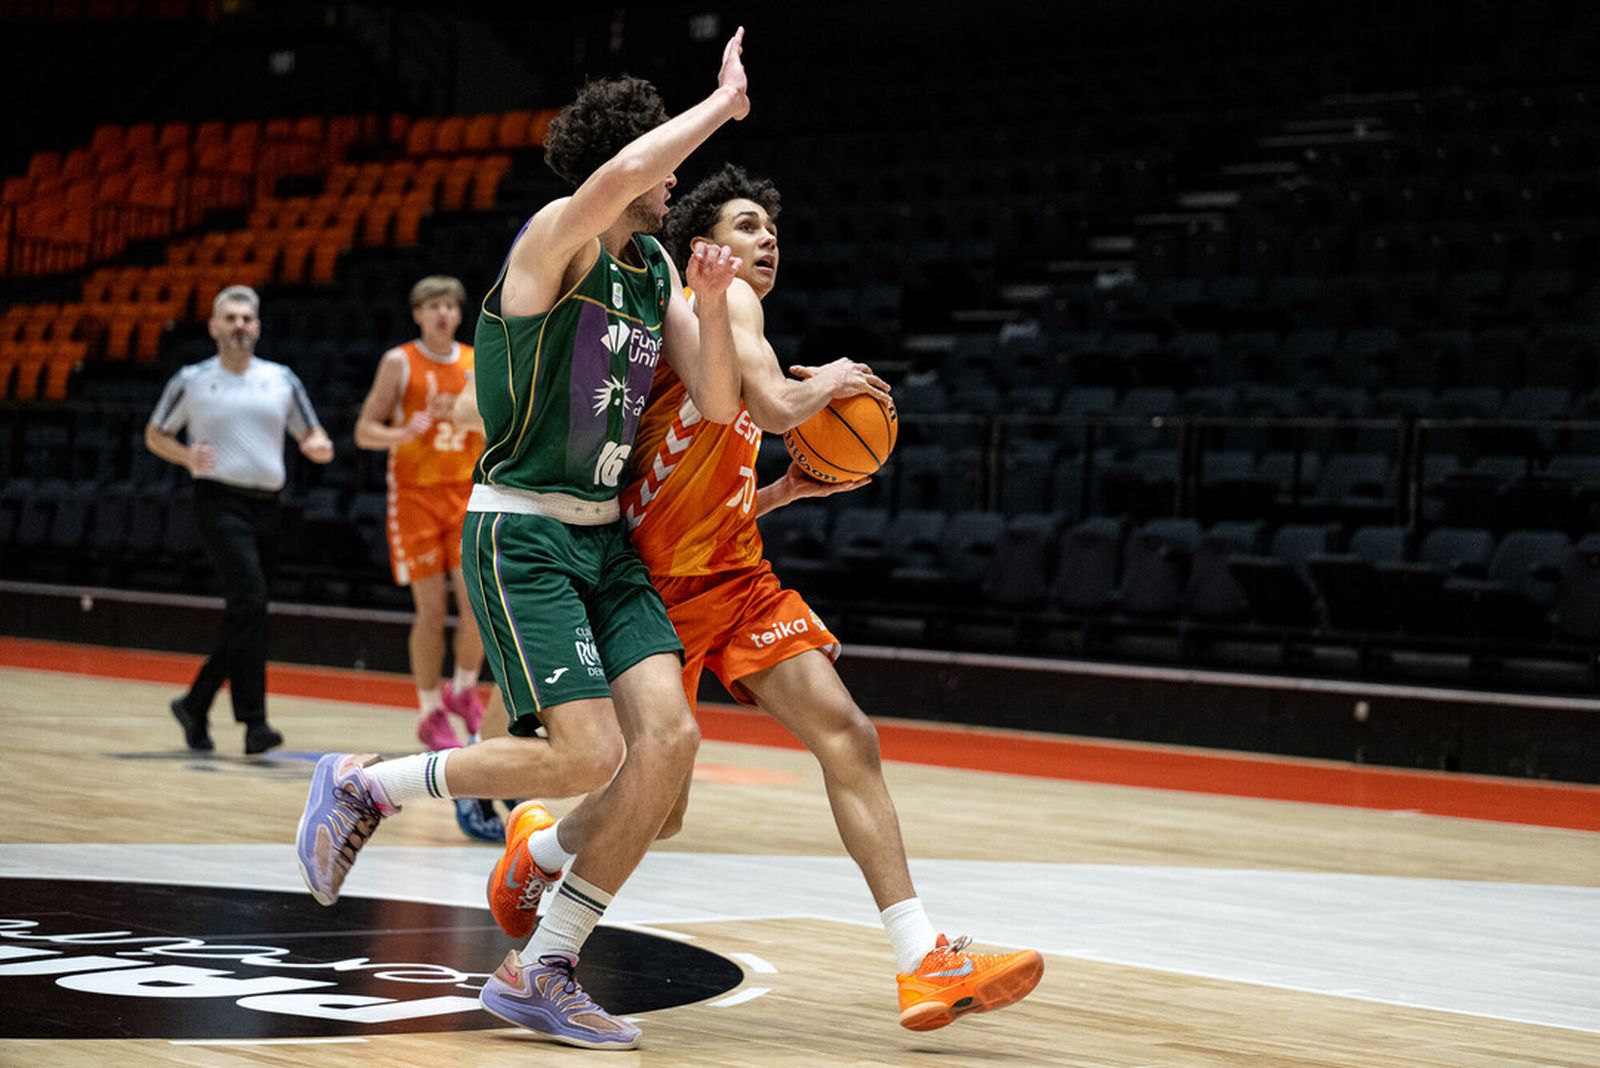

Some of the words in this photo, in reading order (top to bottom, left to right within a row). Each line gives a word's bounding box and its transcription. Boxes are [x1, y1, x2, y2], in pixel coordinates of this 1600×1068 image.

[628, 345, 660, 368] Uni
[593, 441, 632, 487] 16
[751, 618, 809, 648] teika
